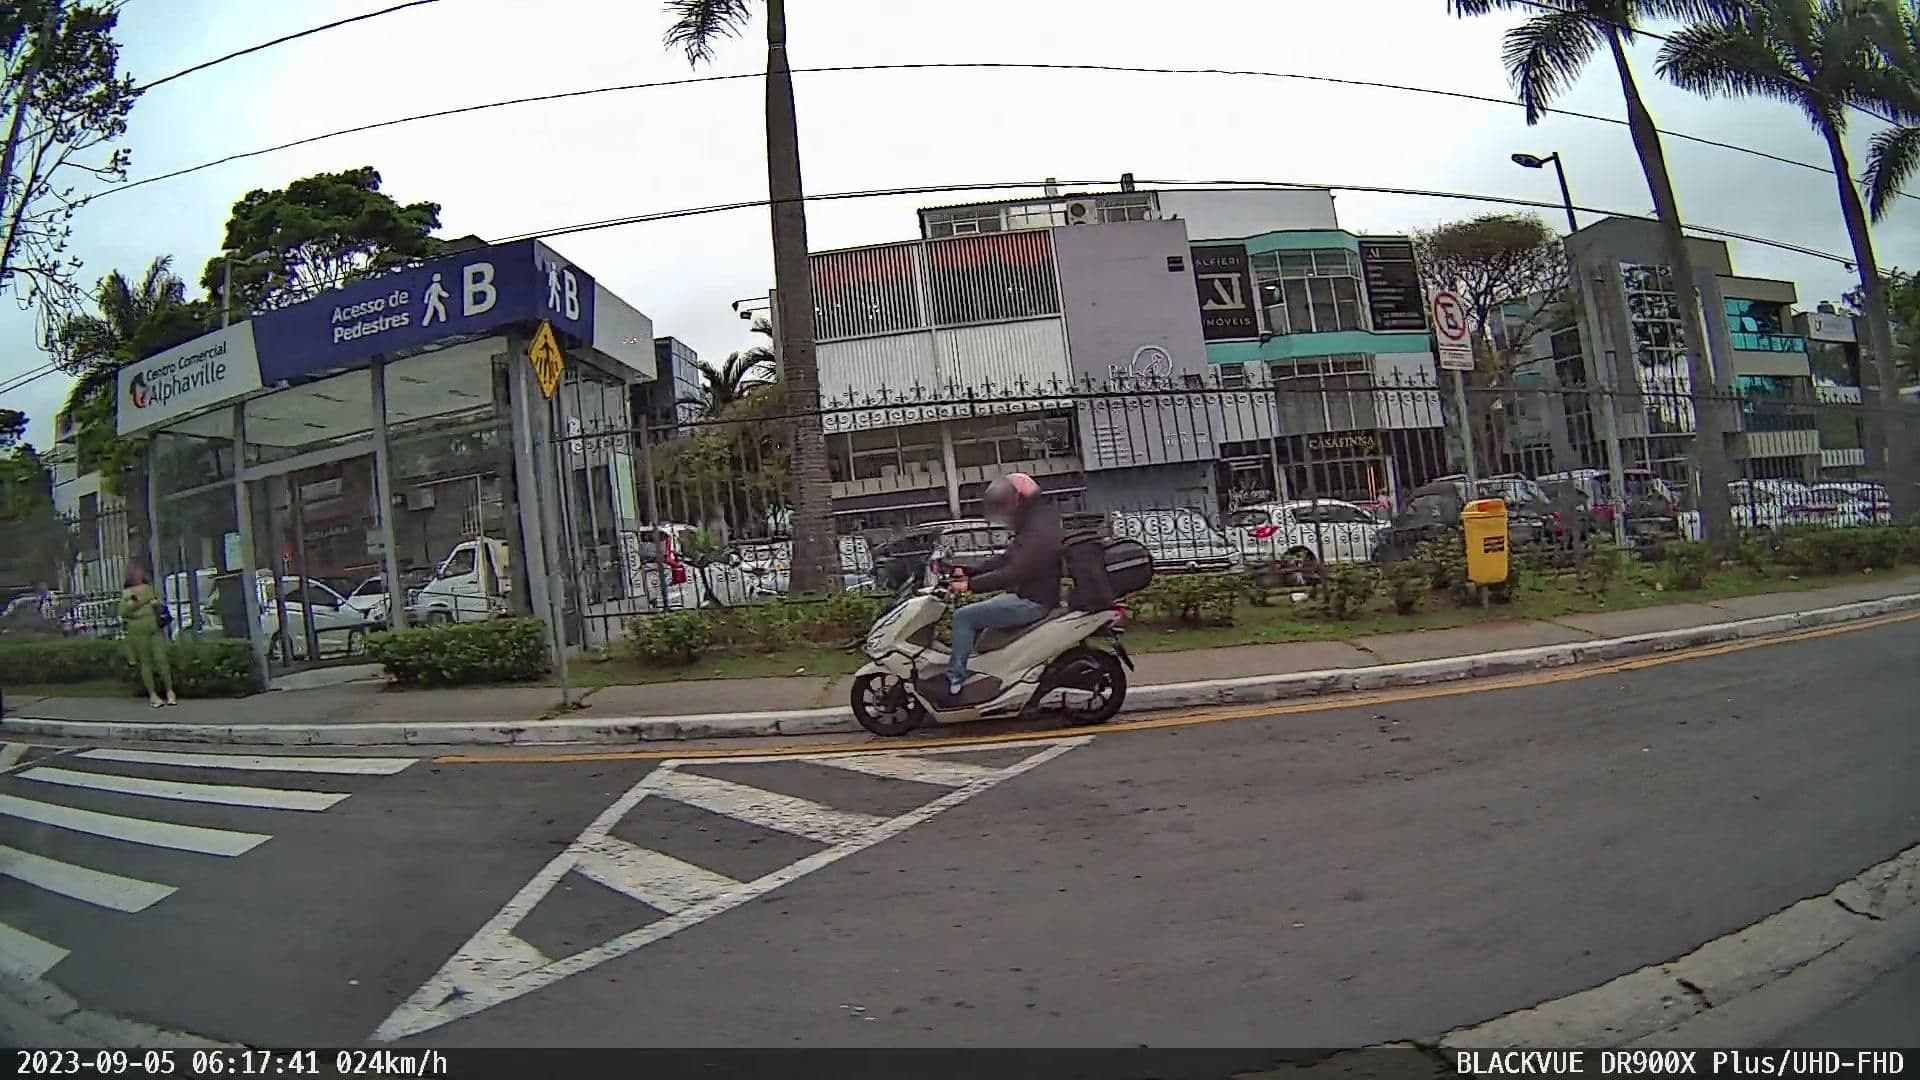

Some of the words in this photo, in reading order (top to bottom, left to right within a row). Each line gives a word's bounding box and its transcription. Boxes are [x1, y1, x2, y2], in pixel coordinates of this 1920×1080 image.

[1196, 256, 1240, 266] ALFIERI
[332, 298, 385, 324] Acesso
[388, 290, 409, 306] de
[463, 262, 497, 317] B
[564, 269, 579, 321] B
[333, 312, 410, 344] Pedestres
[146, 363, 176, 382] Centro
[178, 341, 227, 370] Comercial
[149, 361, 226, 406] Alphaville
